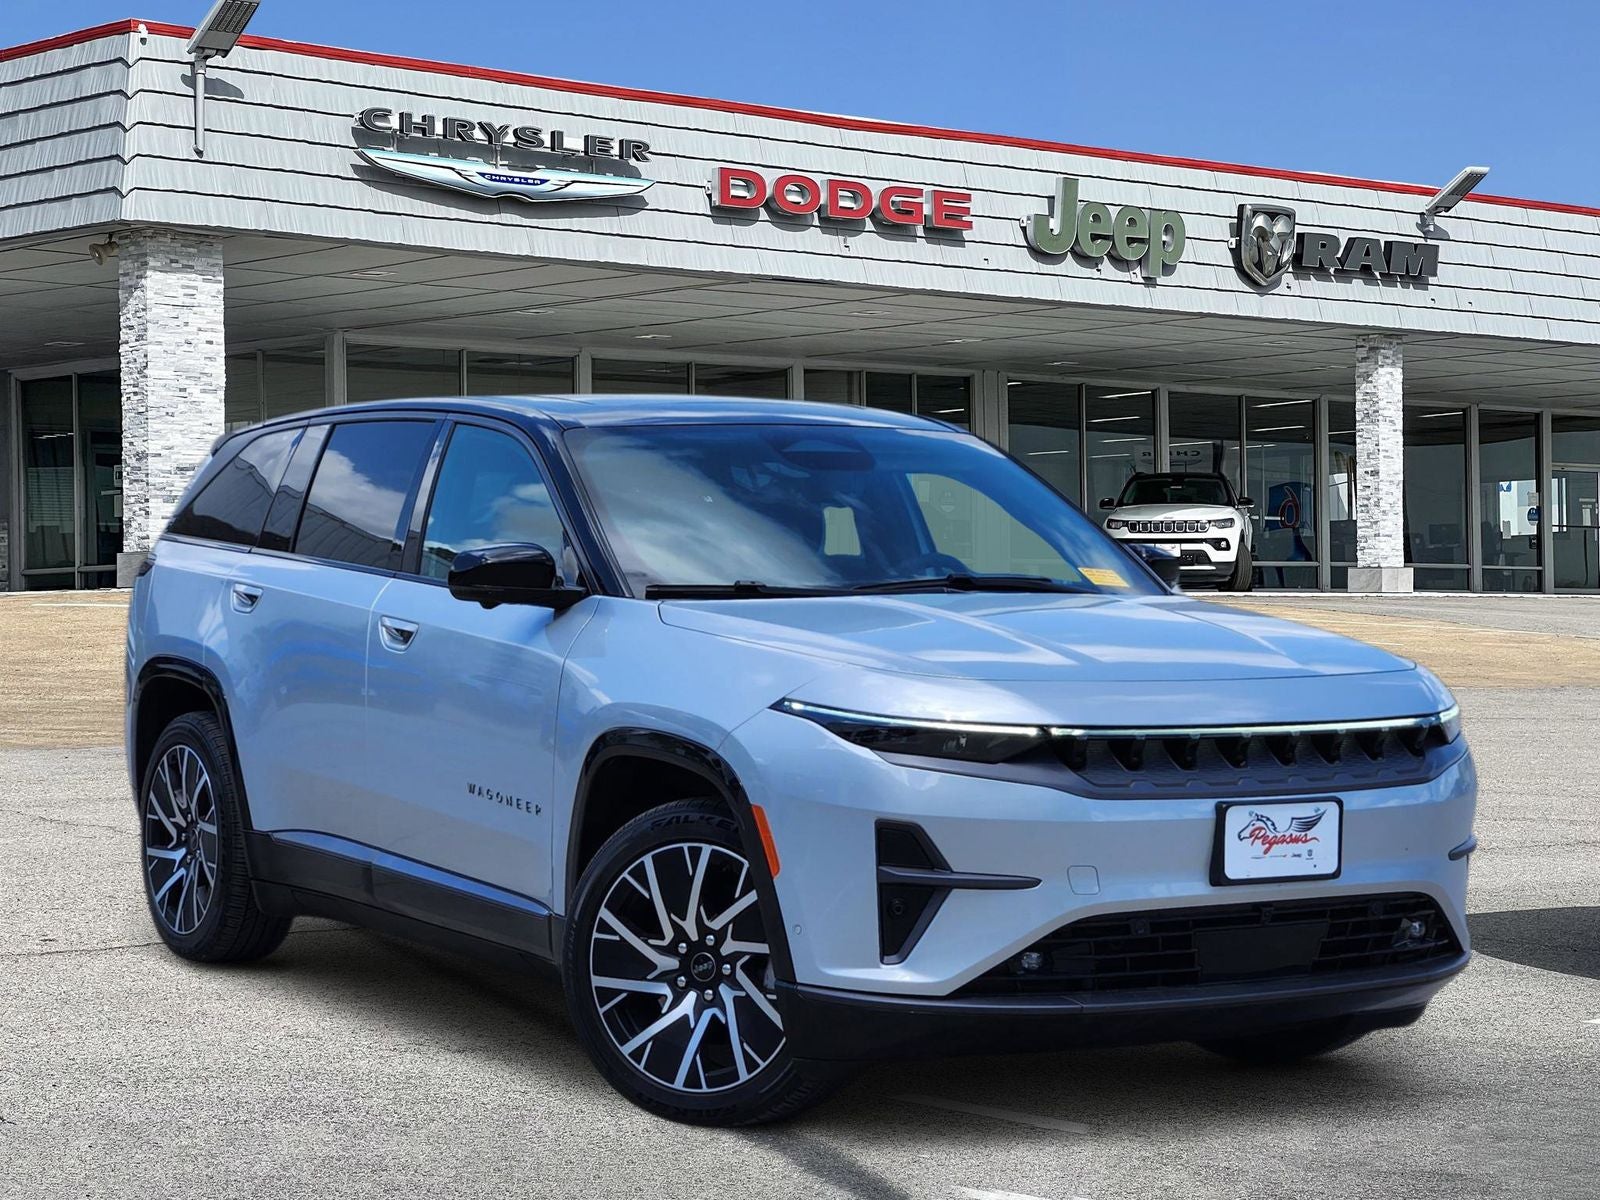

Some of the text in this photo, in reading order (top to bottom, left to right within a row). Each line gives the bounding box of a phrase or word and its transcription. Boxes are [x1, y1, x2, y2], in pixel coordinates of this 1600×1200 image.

[357, 107, 651, 162] CHRYSLER
[484, 174, 542, 185] CHRYSLER
[713, 166, 973, 231] DODGE
[1027, 176, 1187, 278] Jeep
[1299, 232, 1439, 277] RAM
[467, 782, 542, 816] WAGONEER
[1249, 825, 1320, 855] Pegasus
